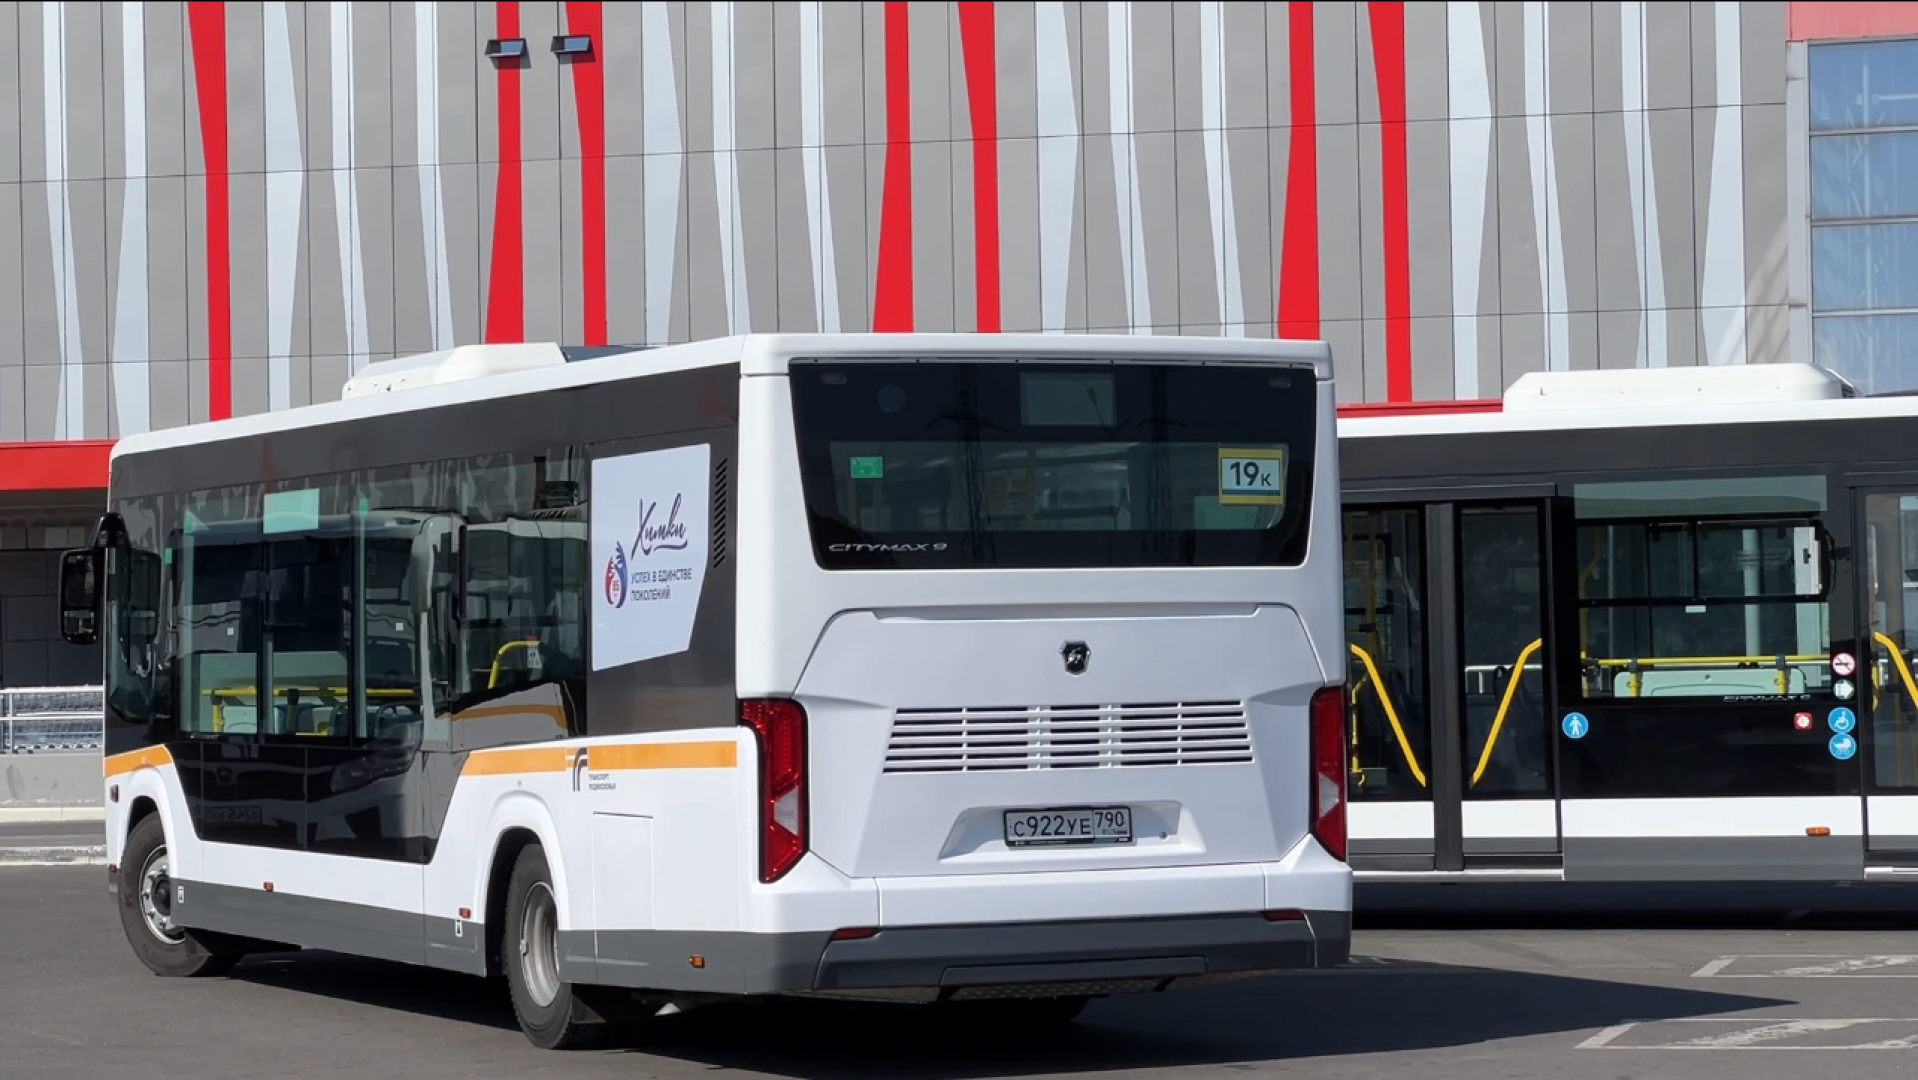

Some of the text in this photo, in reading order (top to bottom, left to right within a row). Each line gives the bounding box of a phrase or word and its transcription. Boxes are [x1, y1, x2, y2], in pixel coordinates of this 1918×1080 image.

[631, 492, 688, 560] Химки
[828, 541, 948, 552] CITYMAX 9
[630, 571, 651, 585] УСПЕХ
[658, 567, 693, 583] ЕДИНСТВЕ
[630, 585, 671, 601] ПОКОЛЕНИЙ
[1094, 810, 1125, 829] 790
